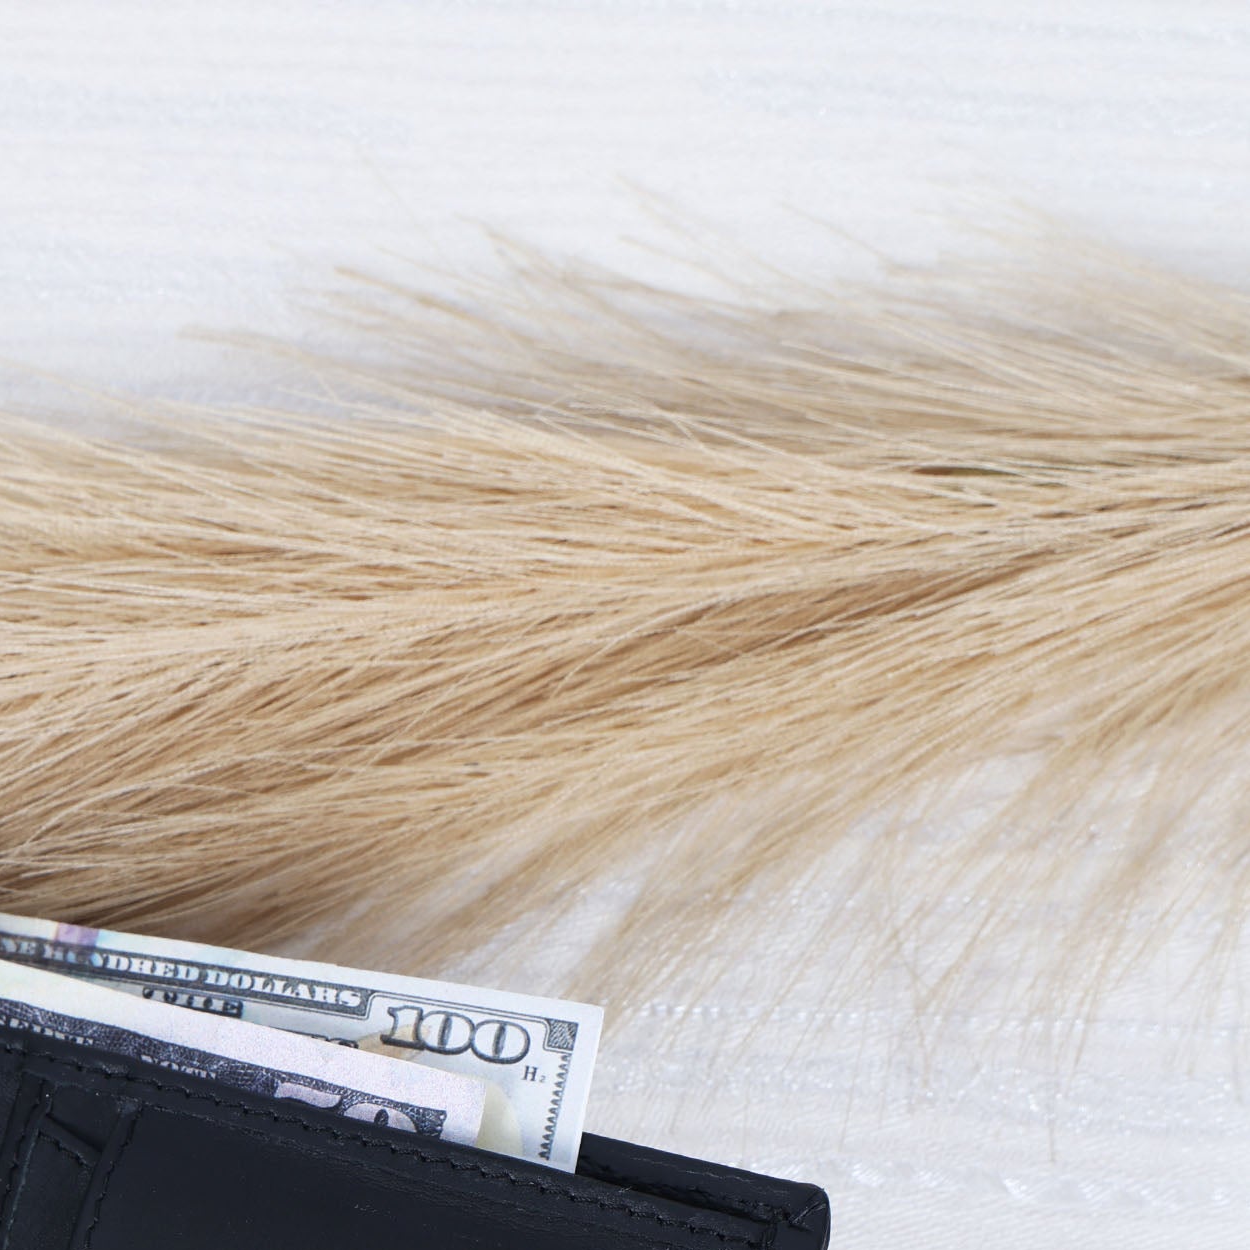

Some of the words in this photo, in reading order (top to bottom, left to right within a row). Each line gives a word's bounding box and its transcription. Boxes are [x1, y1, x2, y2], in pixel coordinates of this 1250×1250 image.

[42, 943, 200, 982] HUNDRED
[203, 968, 361, 1008] DOLLARS
[380, 1004, 531, 1065] 100
